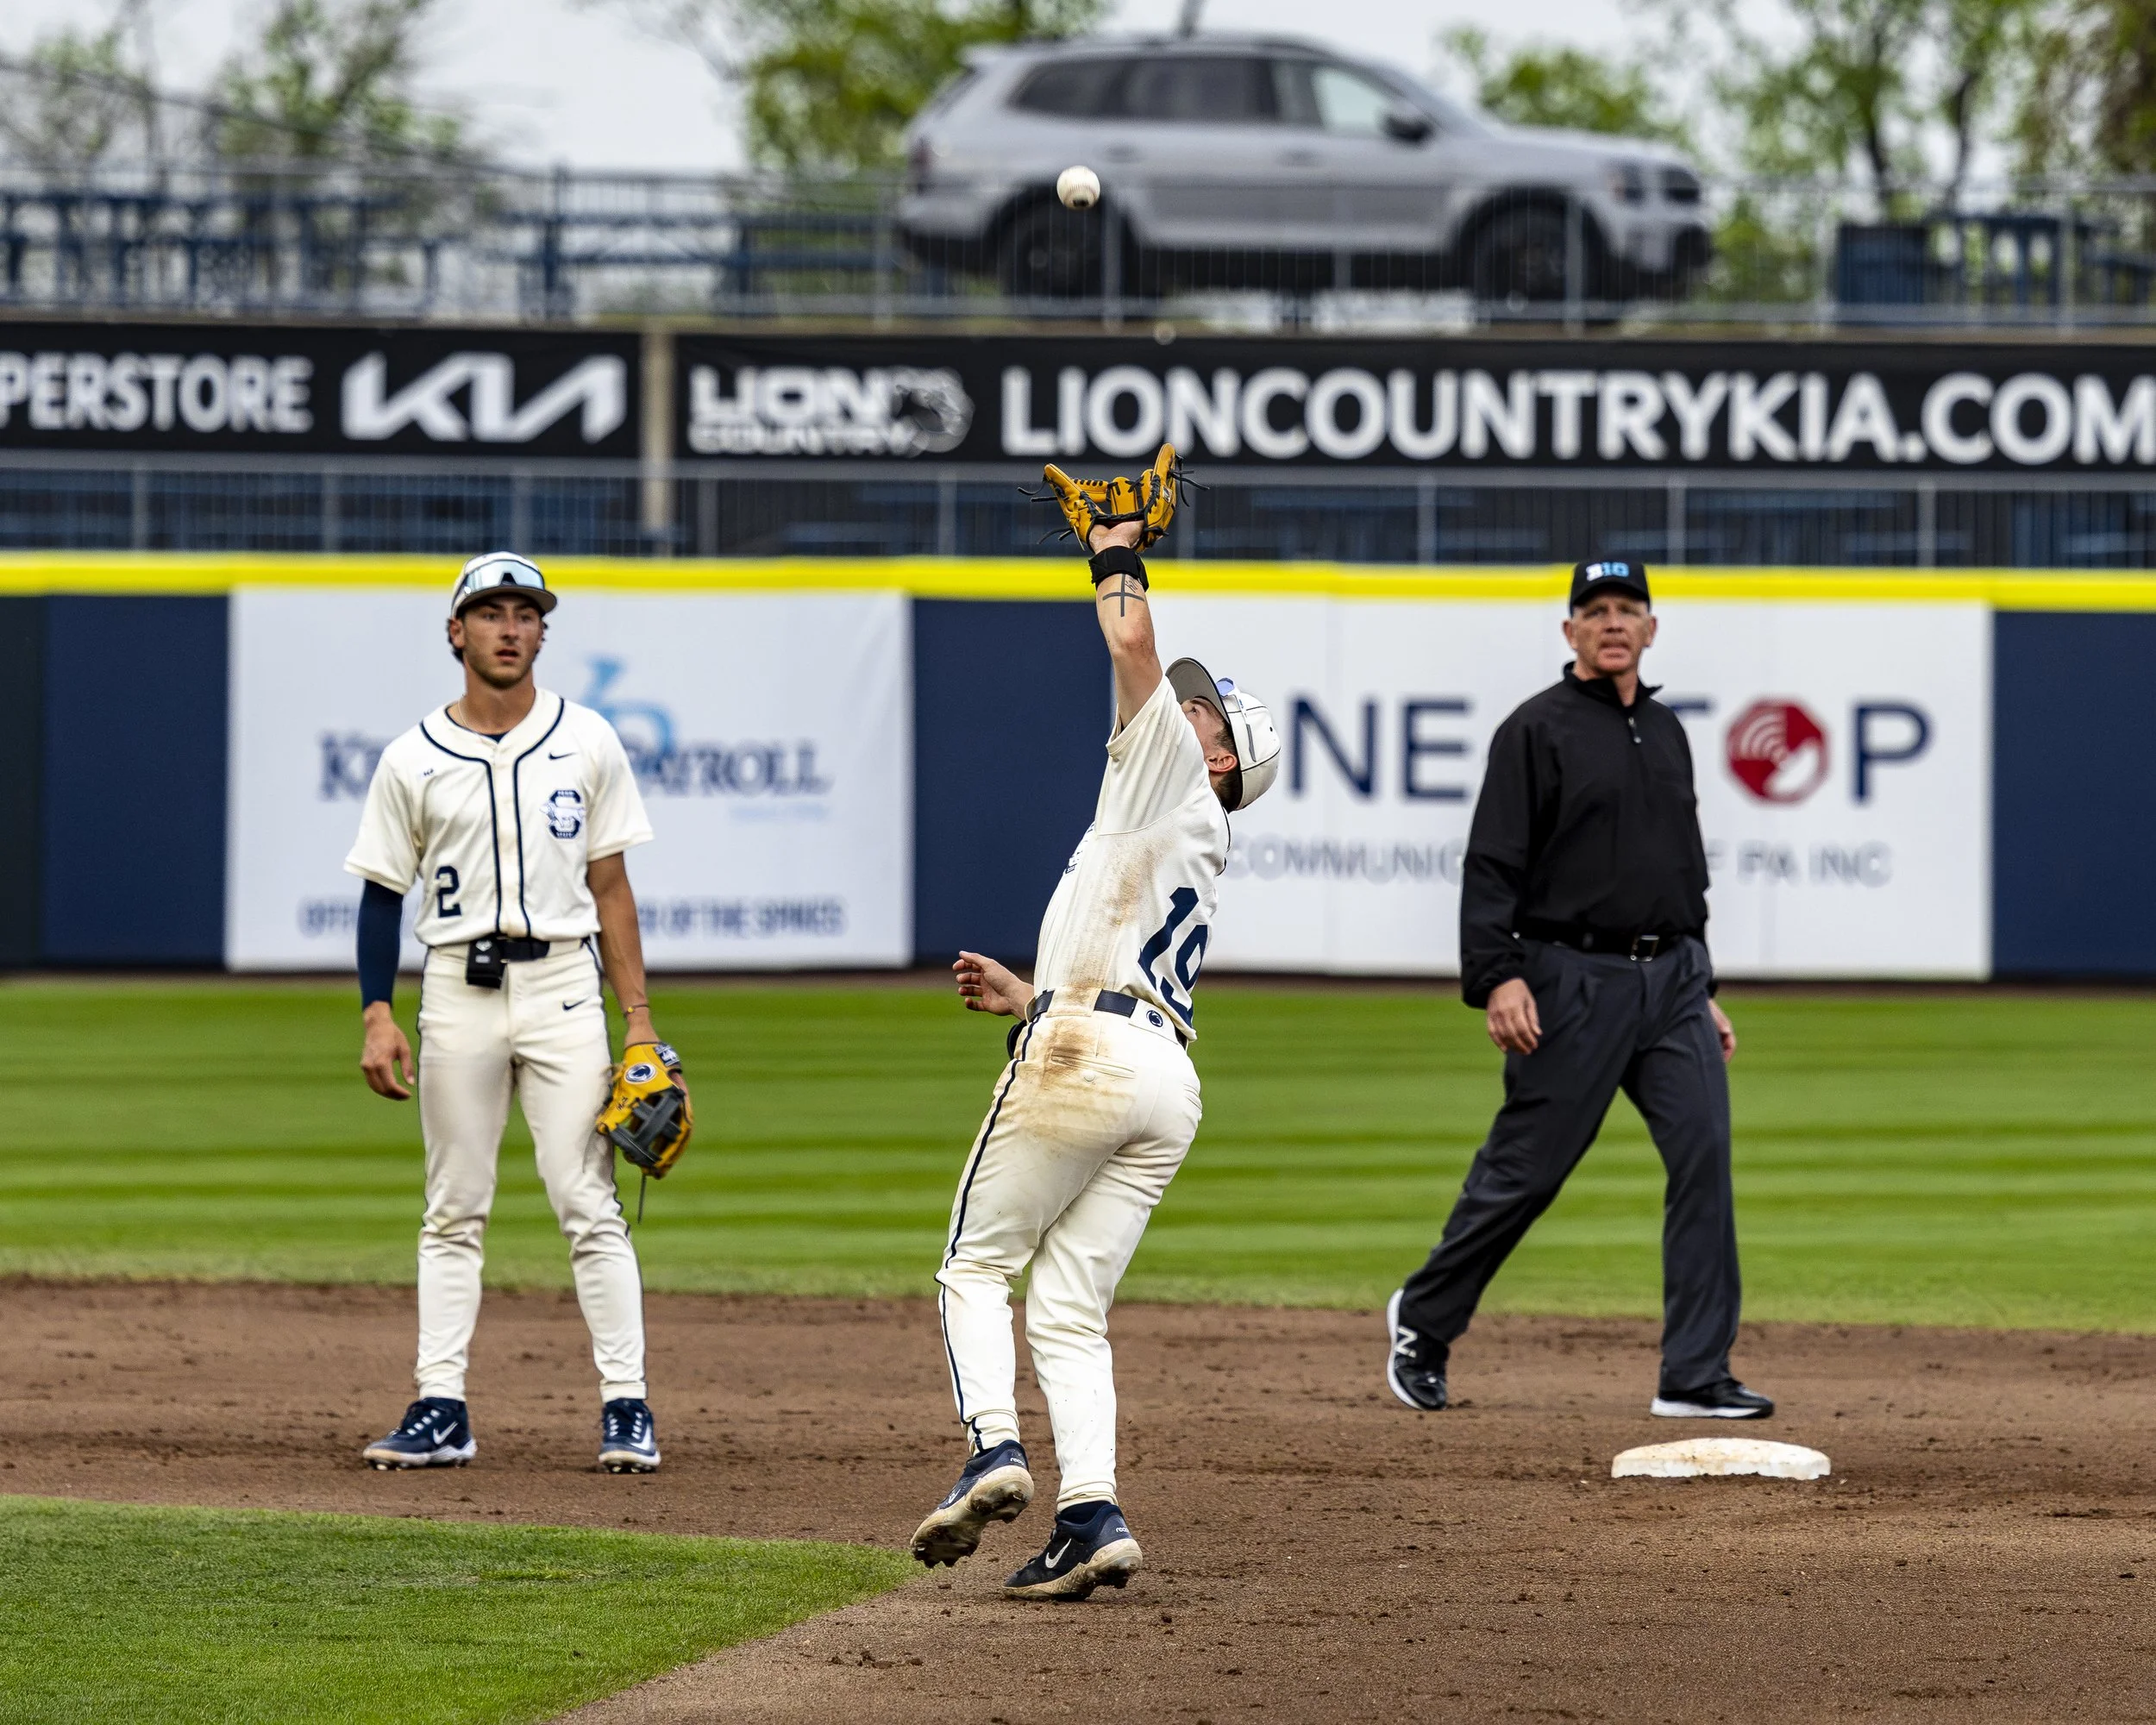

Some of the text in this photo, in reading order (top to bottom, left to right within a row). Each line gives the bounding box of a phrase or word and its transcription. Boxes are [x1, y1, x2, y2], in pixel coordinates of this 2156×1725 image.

[0, 352, 312, 430] PERSTORE
[343, 352, 627, 442] KIA
[691, 364, 892, 427] LION
[1001, 366, 2156, 465] LIONCOUNTRYKIA.COM
[436, 865, 461, 918] 2
[1735, 837, 1802, 888] PA
[1808, 837, 1896, 888] INC
[1138, 887, 1208, 1029] 19
